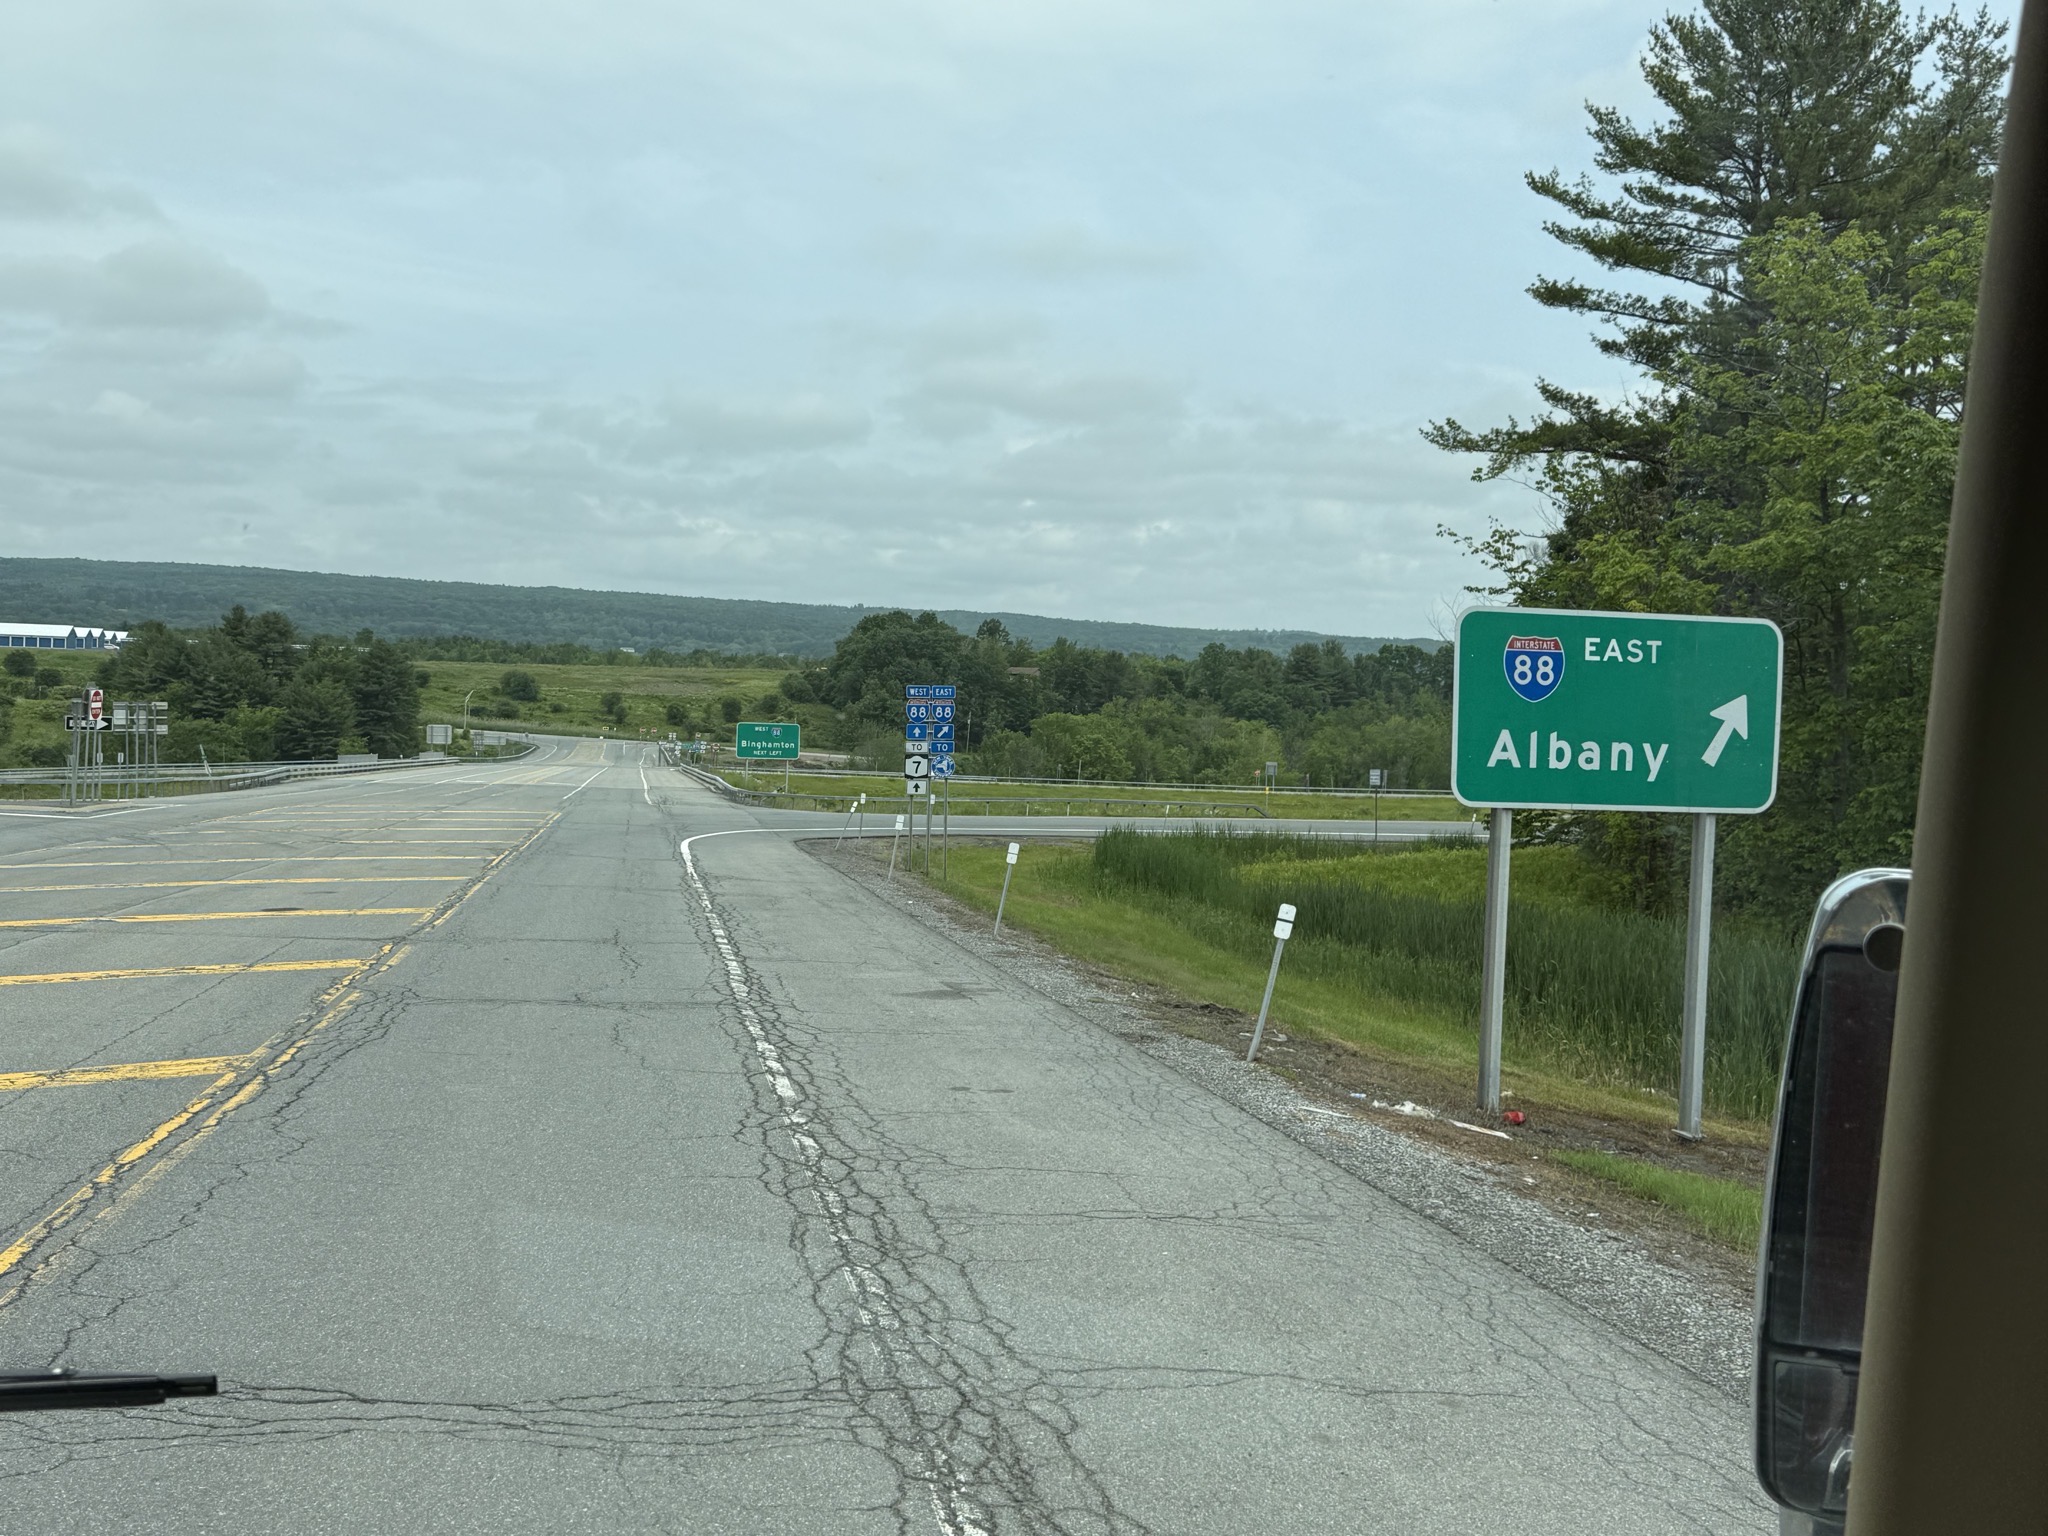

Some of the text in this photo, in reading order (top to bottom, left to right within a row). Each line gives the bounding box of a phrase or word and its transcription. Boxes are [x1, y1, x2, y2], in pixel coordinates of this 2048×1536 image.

[1513, 640, 1556, 650] INTERSTATE
[1584, 637, 1662, 664] EAST
[1513, 654, 1555, 686] 88
[910, 688, 927, 696] WEST
[935, 688, 952, 696] EAST
[910, 706, 926, 718] 88
[935, 706, 952, 718] 88
[741, 740, 795, 749] Binghamton
[911, 743, 923, 751] TO
[936, 743, 949, 751] TO
[1486, 729, 1669, 782] Albany
[912, 761, 922, 774] 7
